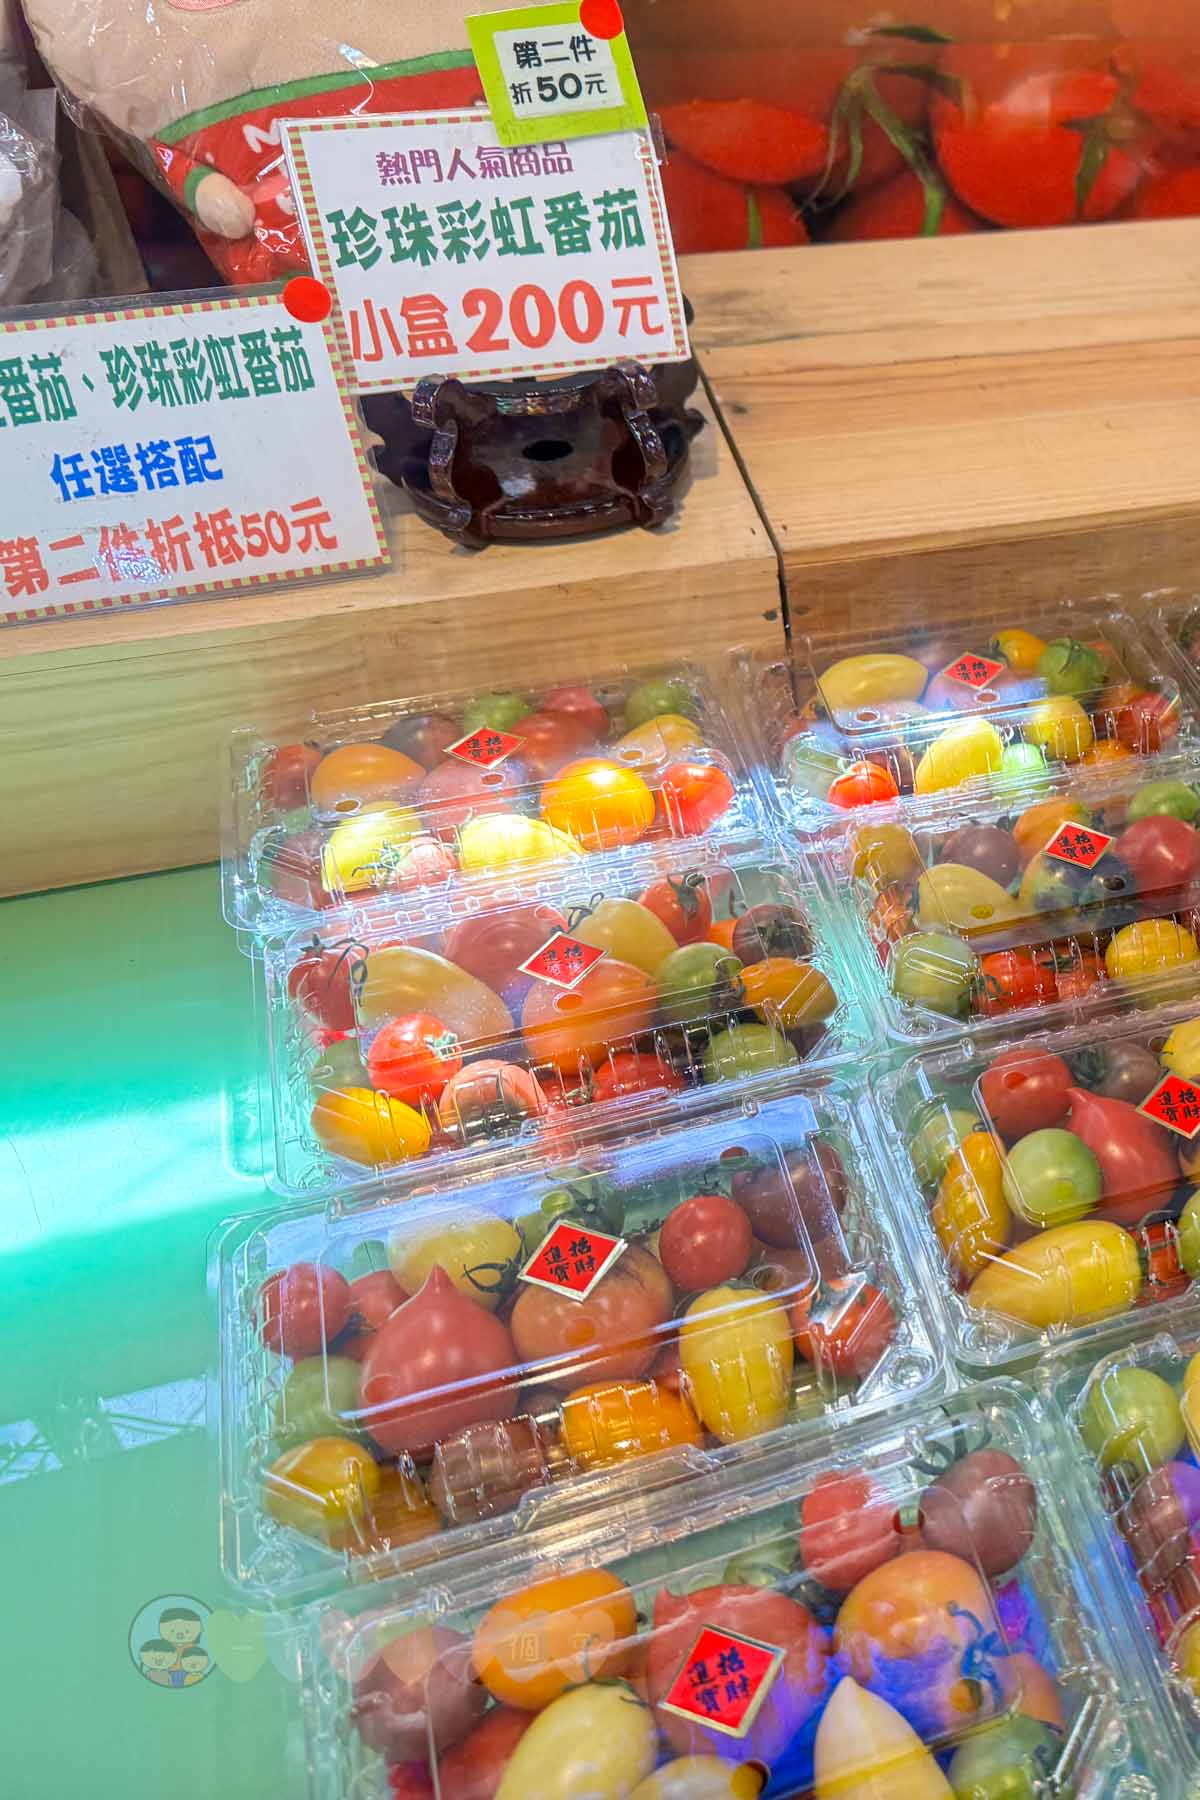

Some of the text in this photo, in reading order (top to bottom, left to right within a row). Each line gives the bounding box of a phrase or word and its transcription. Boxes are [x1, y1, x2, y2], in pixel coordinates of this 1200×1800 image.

[513, 34, 597, 69] 第二件
[510, 72, 607, 105] 折50元
[376, 141, 574, 186] 熱門人氣商品
[325, 188, 647, 271] 珍珠彩虹番茄
[349, 276, 664, 363] 小盒200元
[0, 325, 316, 428] 番茄、珍珠彩虹番茄
[50, 434, 224, 501] 任選搭配
